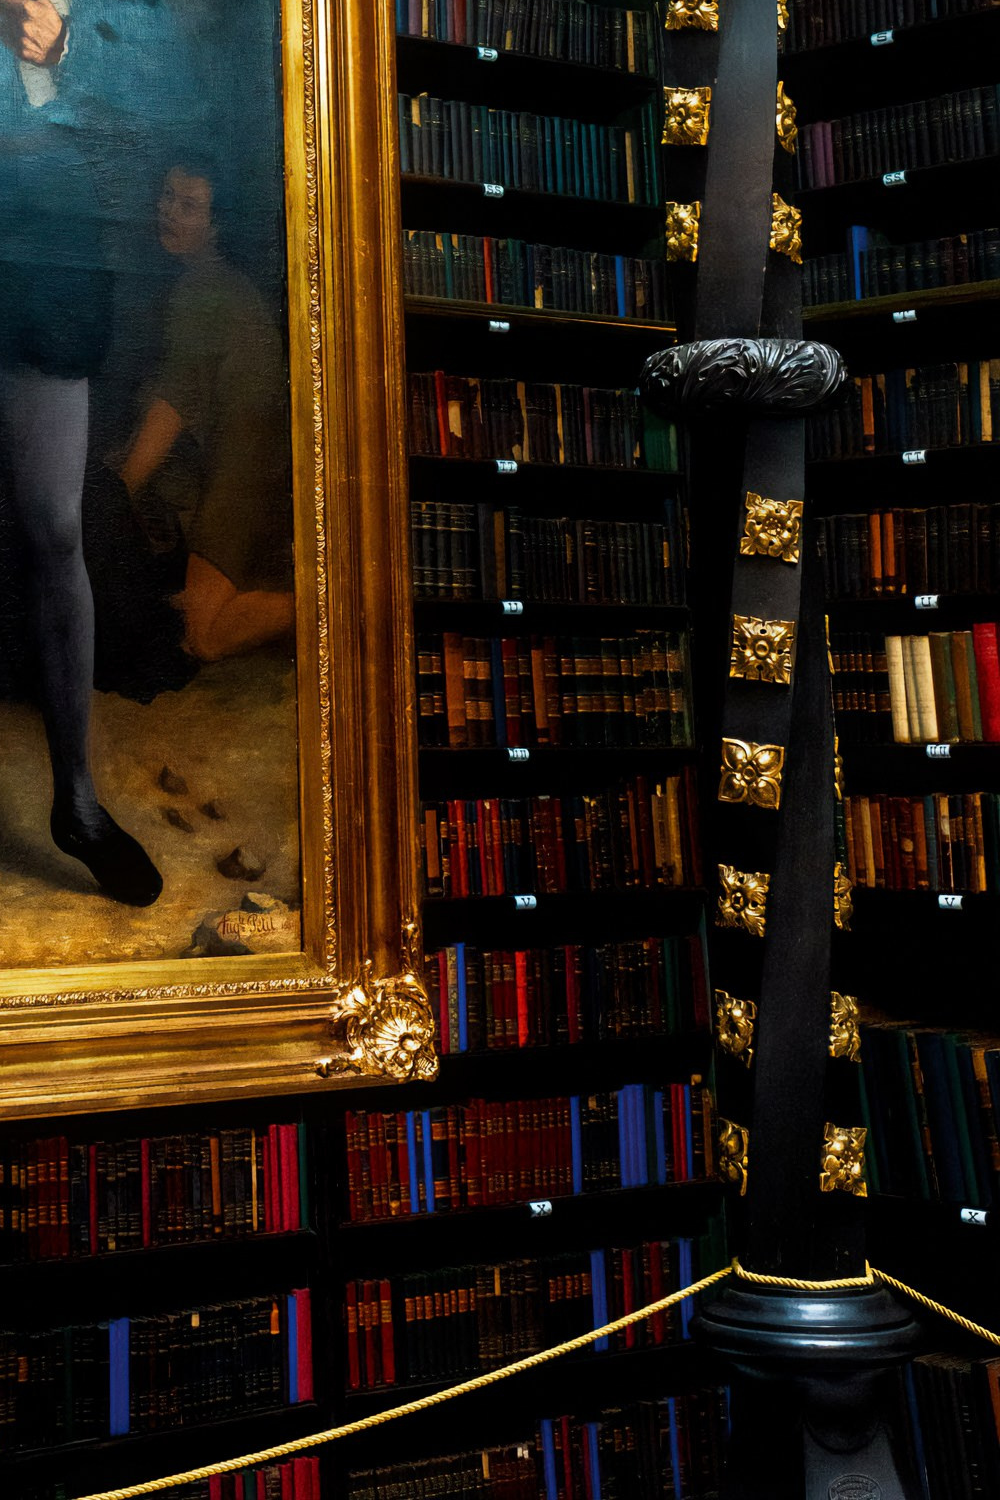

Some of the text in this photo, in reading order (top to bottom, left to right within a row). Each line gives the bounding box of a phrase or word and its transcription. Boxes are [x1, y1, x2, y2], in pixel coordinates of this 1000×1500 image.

[877, 33, 887, 42] S
[484, 48, 493, 58] S
[921, 597, 931, 607] U
[508, 603, 517, 612] U
[521, 898, 530, 907] V
[945, 897, 955, 907] V
[537, 1204, 546, 1214] X
[968, 1211, 980, 1223] X
